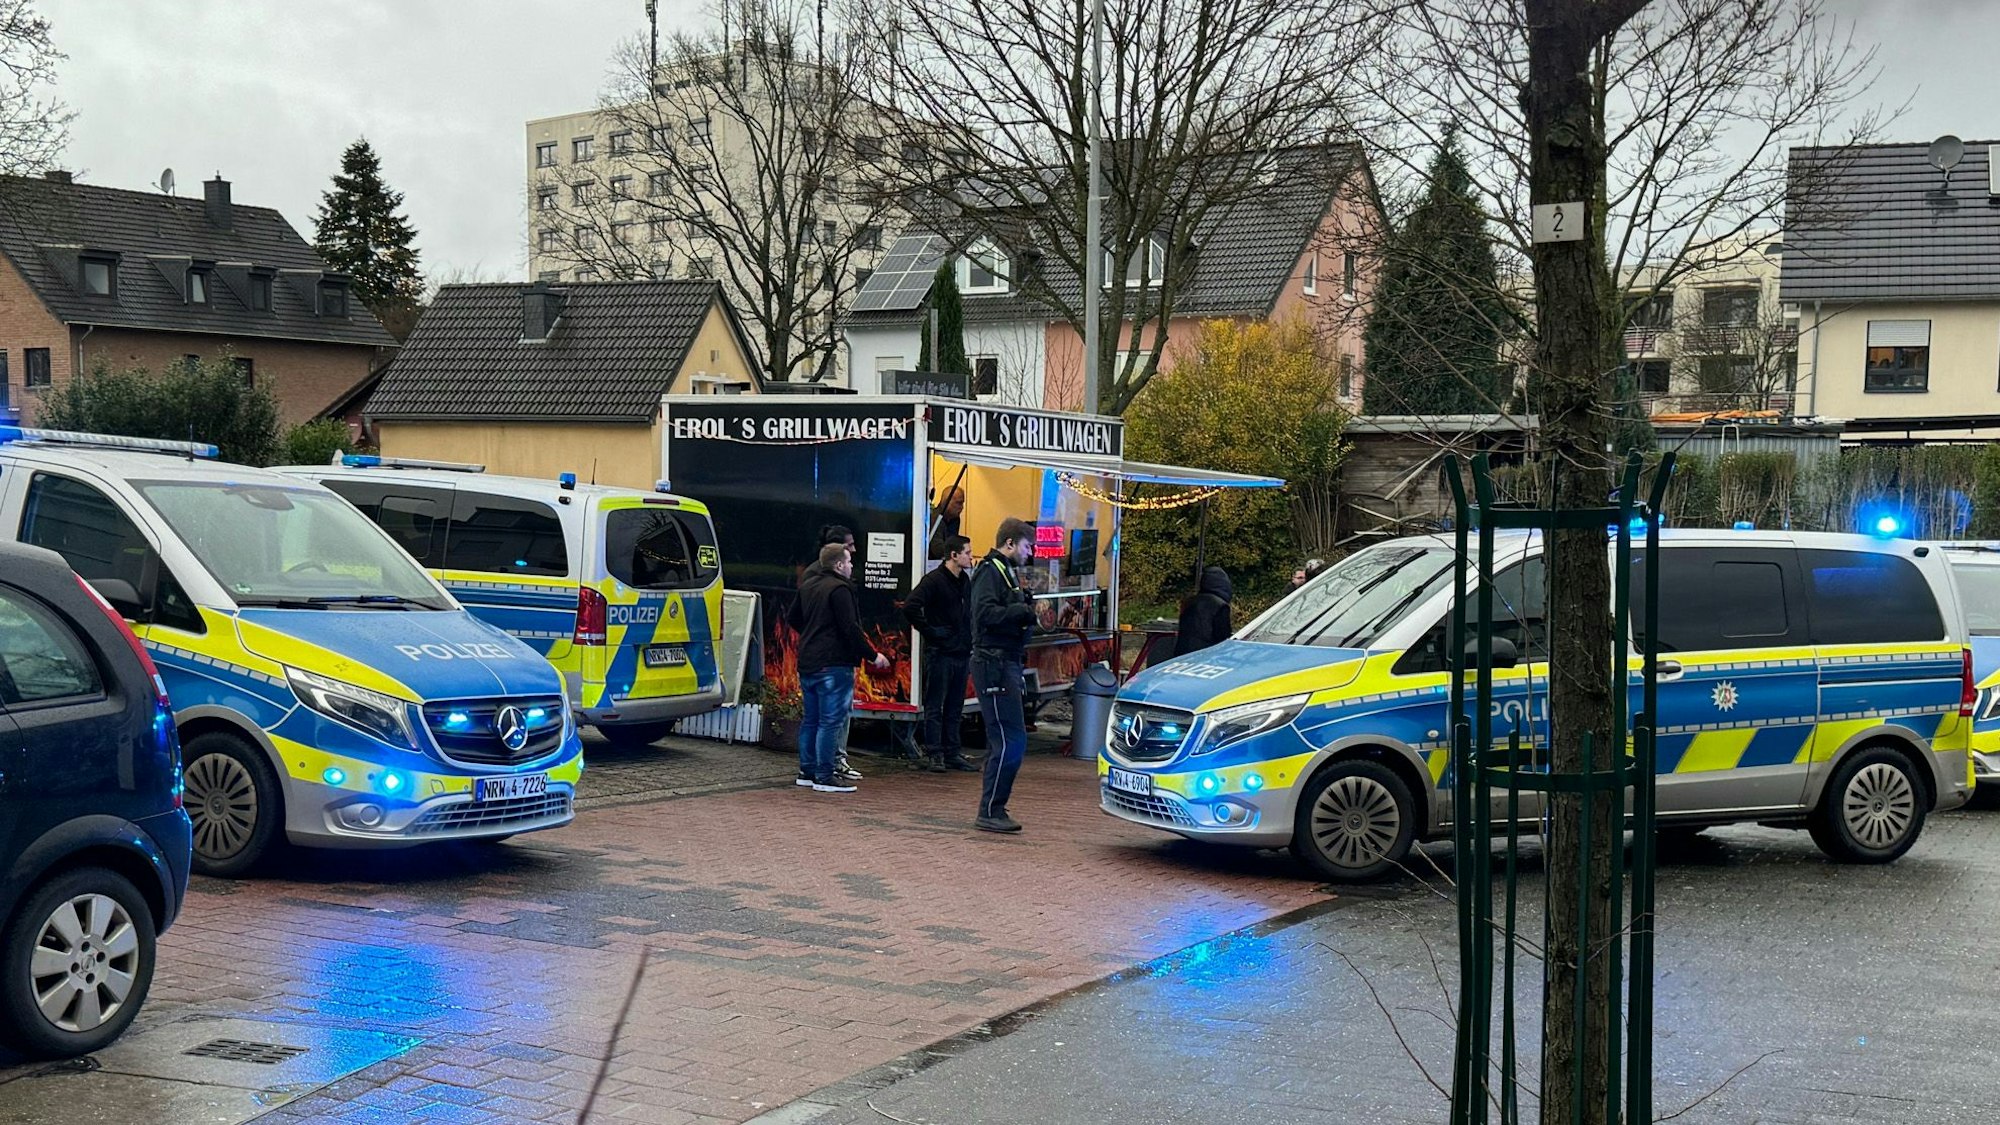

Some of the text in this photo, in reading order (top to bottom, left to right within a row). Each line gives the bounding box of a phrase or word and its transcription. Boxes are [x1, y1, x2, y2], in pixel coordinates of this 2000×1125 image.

[1553, 212, 1564, 232] 2
[762, 417, 908, 440] GRILLWAGEN
[1015, 415, 1113, 455] GRILLWAGEN
[608, 606, 659, 624] POLIZEI
[394, 643, 516, 661] POLIZEI
[1154, 662, 1234, 680] POLIZEI
[1490, 698, 1548, 723] POLI
[484, 774, 546, 798] NRW 4-7226
